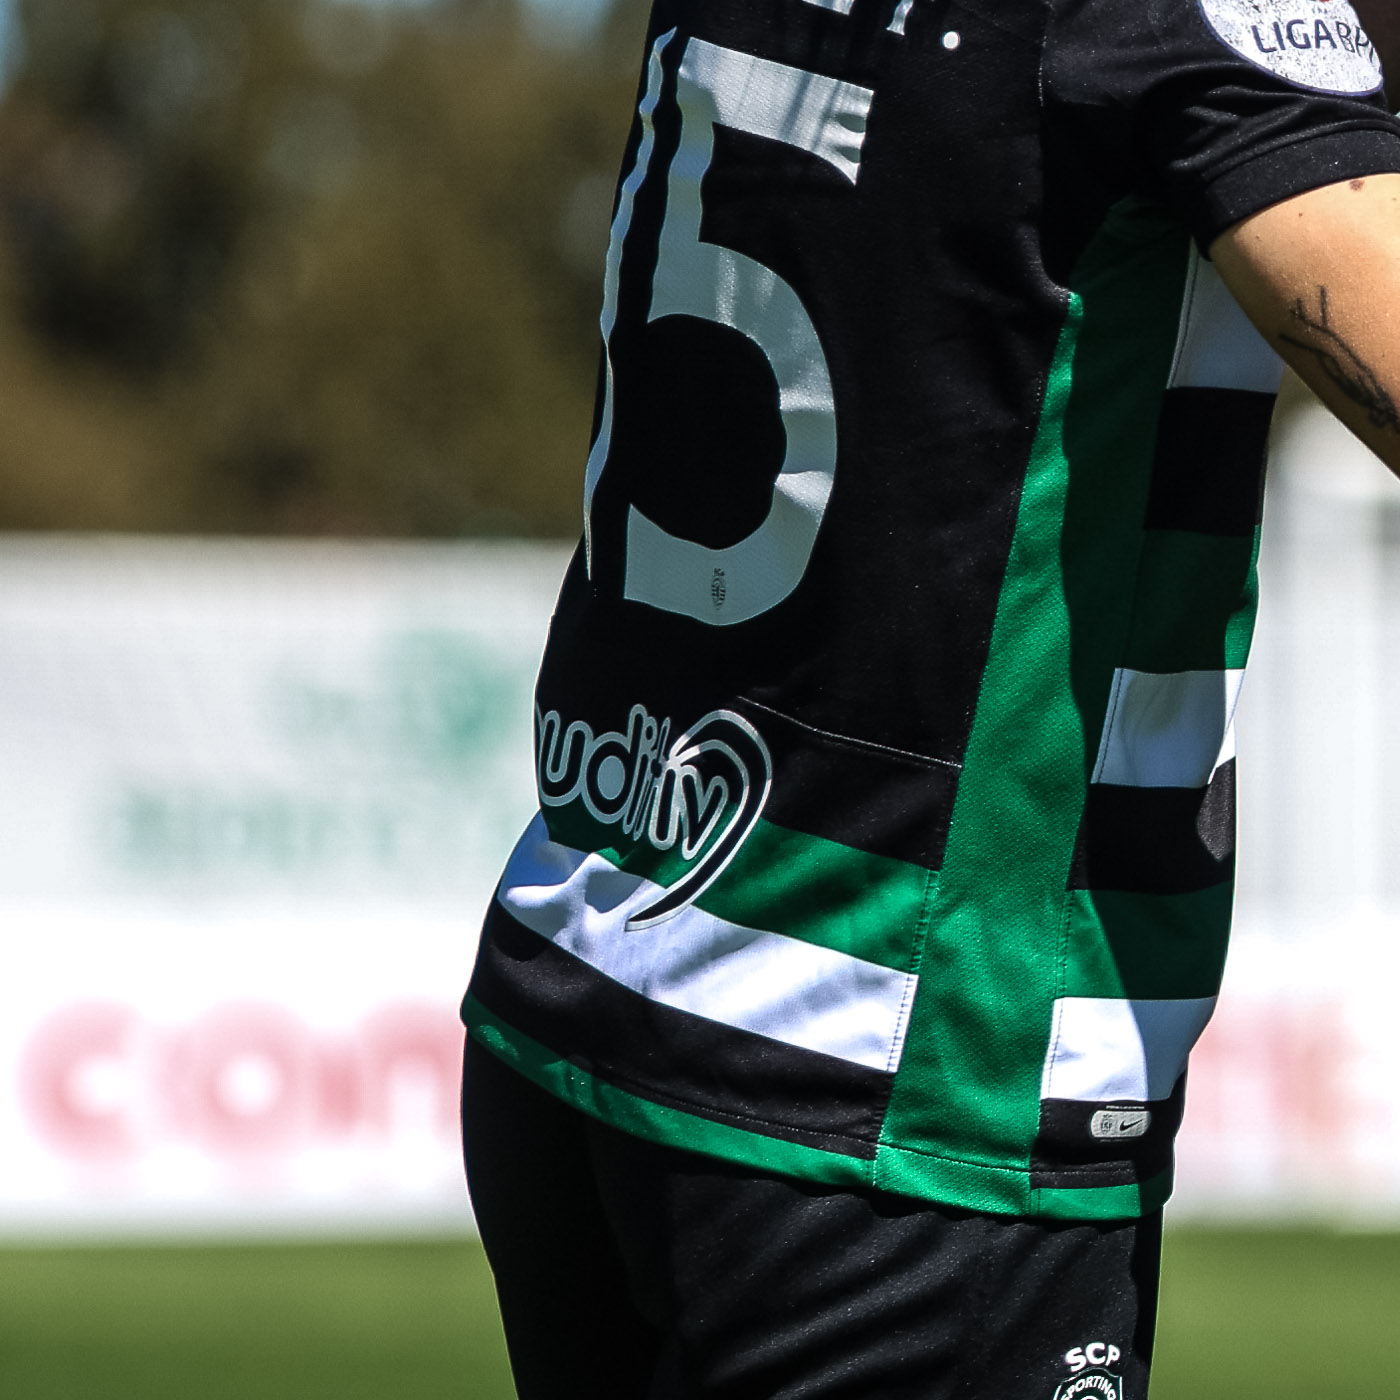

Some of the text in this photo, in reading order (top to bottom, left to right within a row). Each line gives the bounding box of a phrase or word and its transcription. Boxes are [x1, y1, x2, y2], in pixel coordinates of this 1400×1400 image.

[582, 26, 875, 627] 15
[536, 703, 772, 860] uditiv
[1065, 1341, 1121, 1373] SCP
